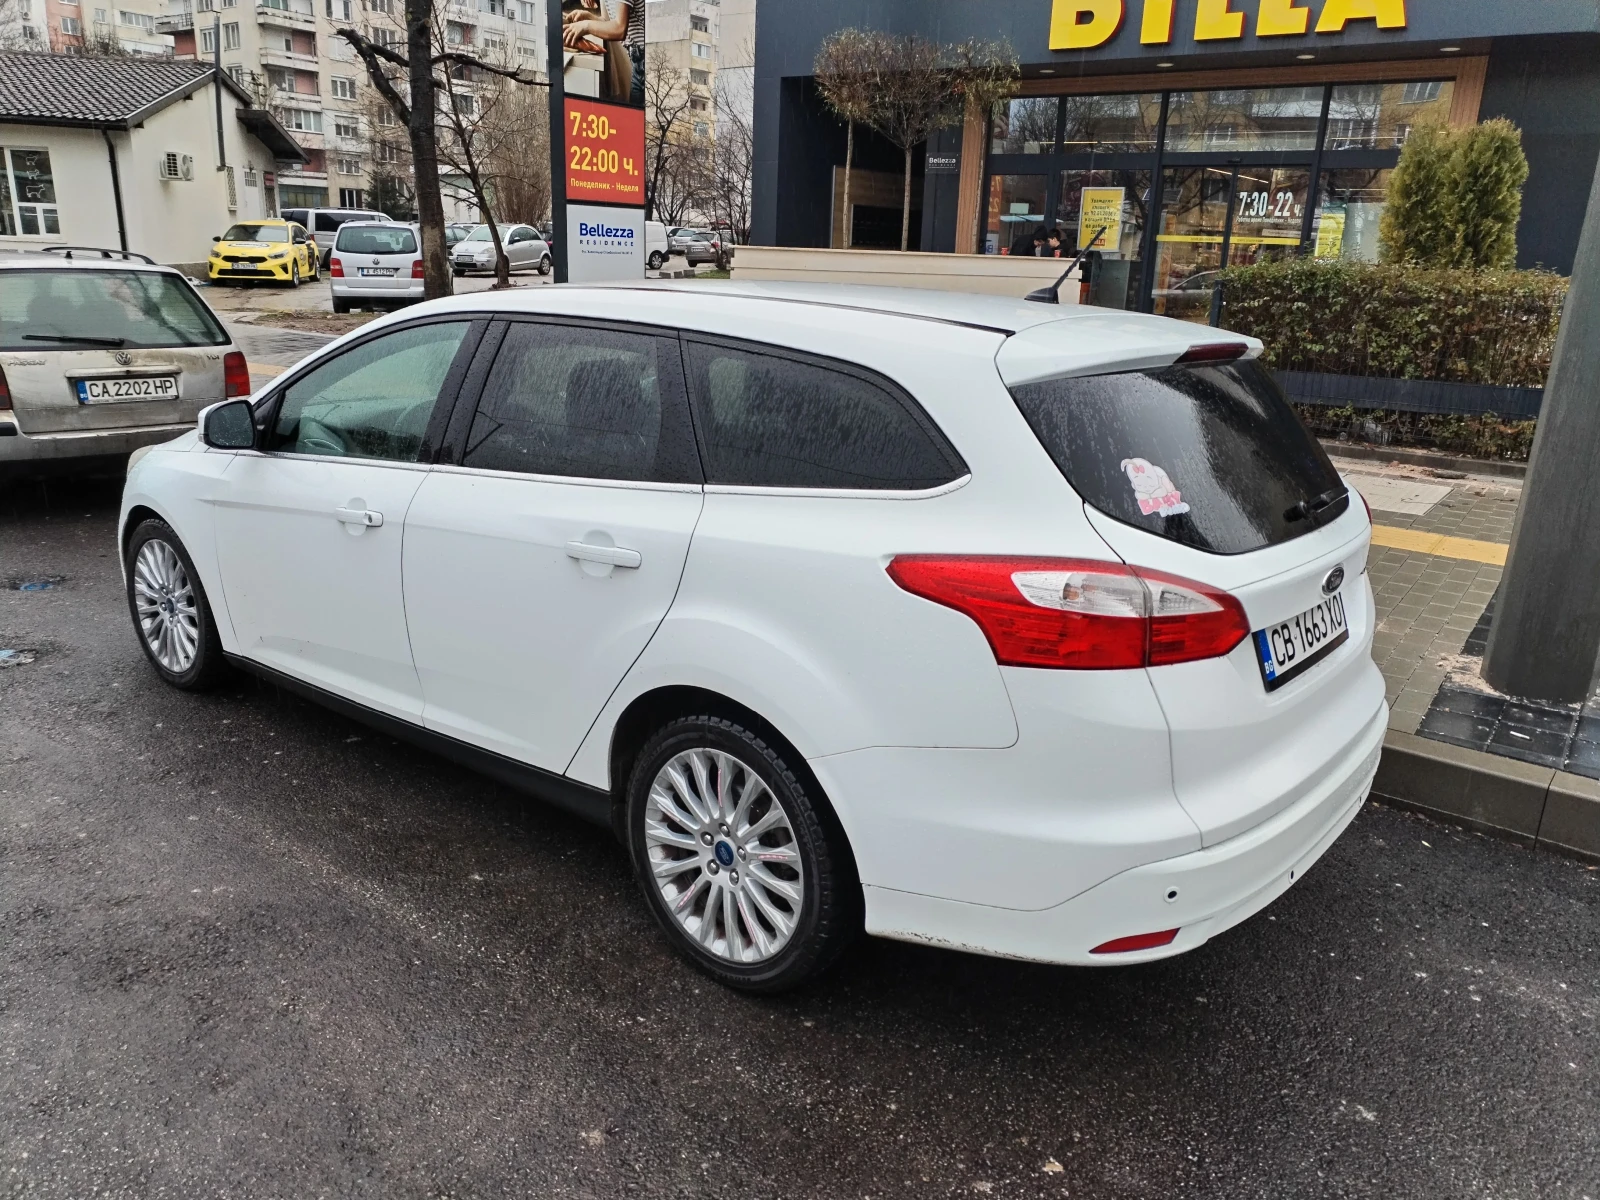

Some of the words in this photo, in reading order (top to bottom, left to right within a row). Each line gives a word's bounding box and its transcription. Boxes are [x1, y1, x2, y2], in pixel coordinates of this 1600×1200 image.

[570, 111, 617, 140] 7:30-
[570, 145, 619, 174] 22:00
[623, 156, 639, 176] ч.
[570, 177, 611, 190] Понеделник
[615, 182, 639, 192] Неделя
[1238, 191, 1294, 217] 7:30-22
[1294, 204, 1302, 217] ч.
[579, 222, 634, 239] Bellezza
[580, 239, 634, 247] RESIDENCE
[113, 380, 152, 397] 2202
[153, 379, 173, 395] HP
[1295, 604, 1328, 654] 1663
[1263, 659, 1274, 675] BG
